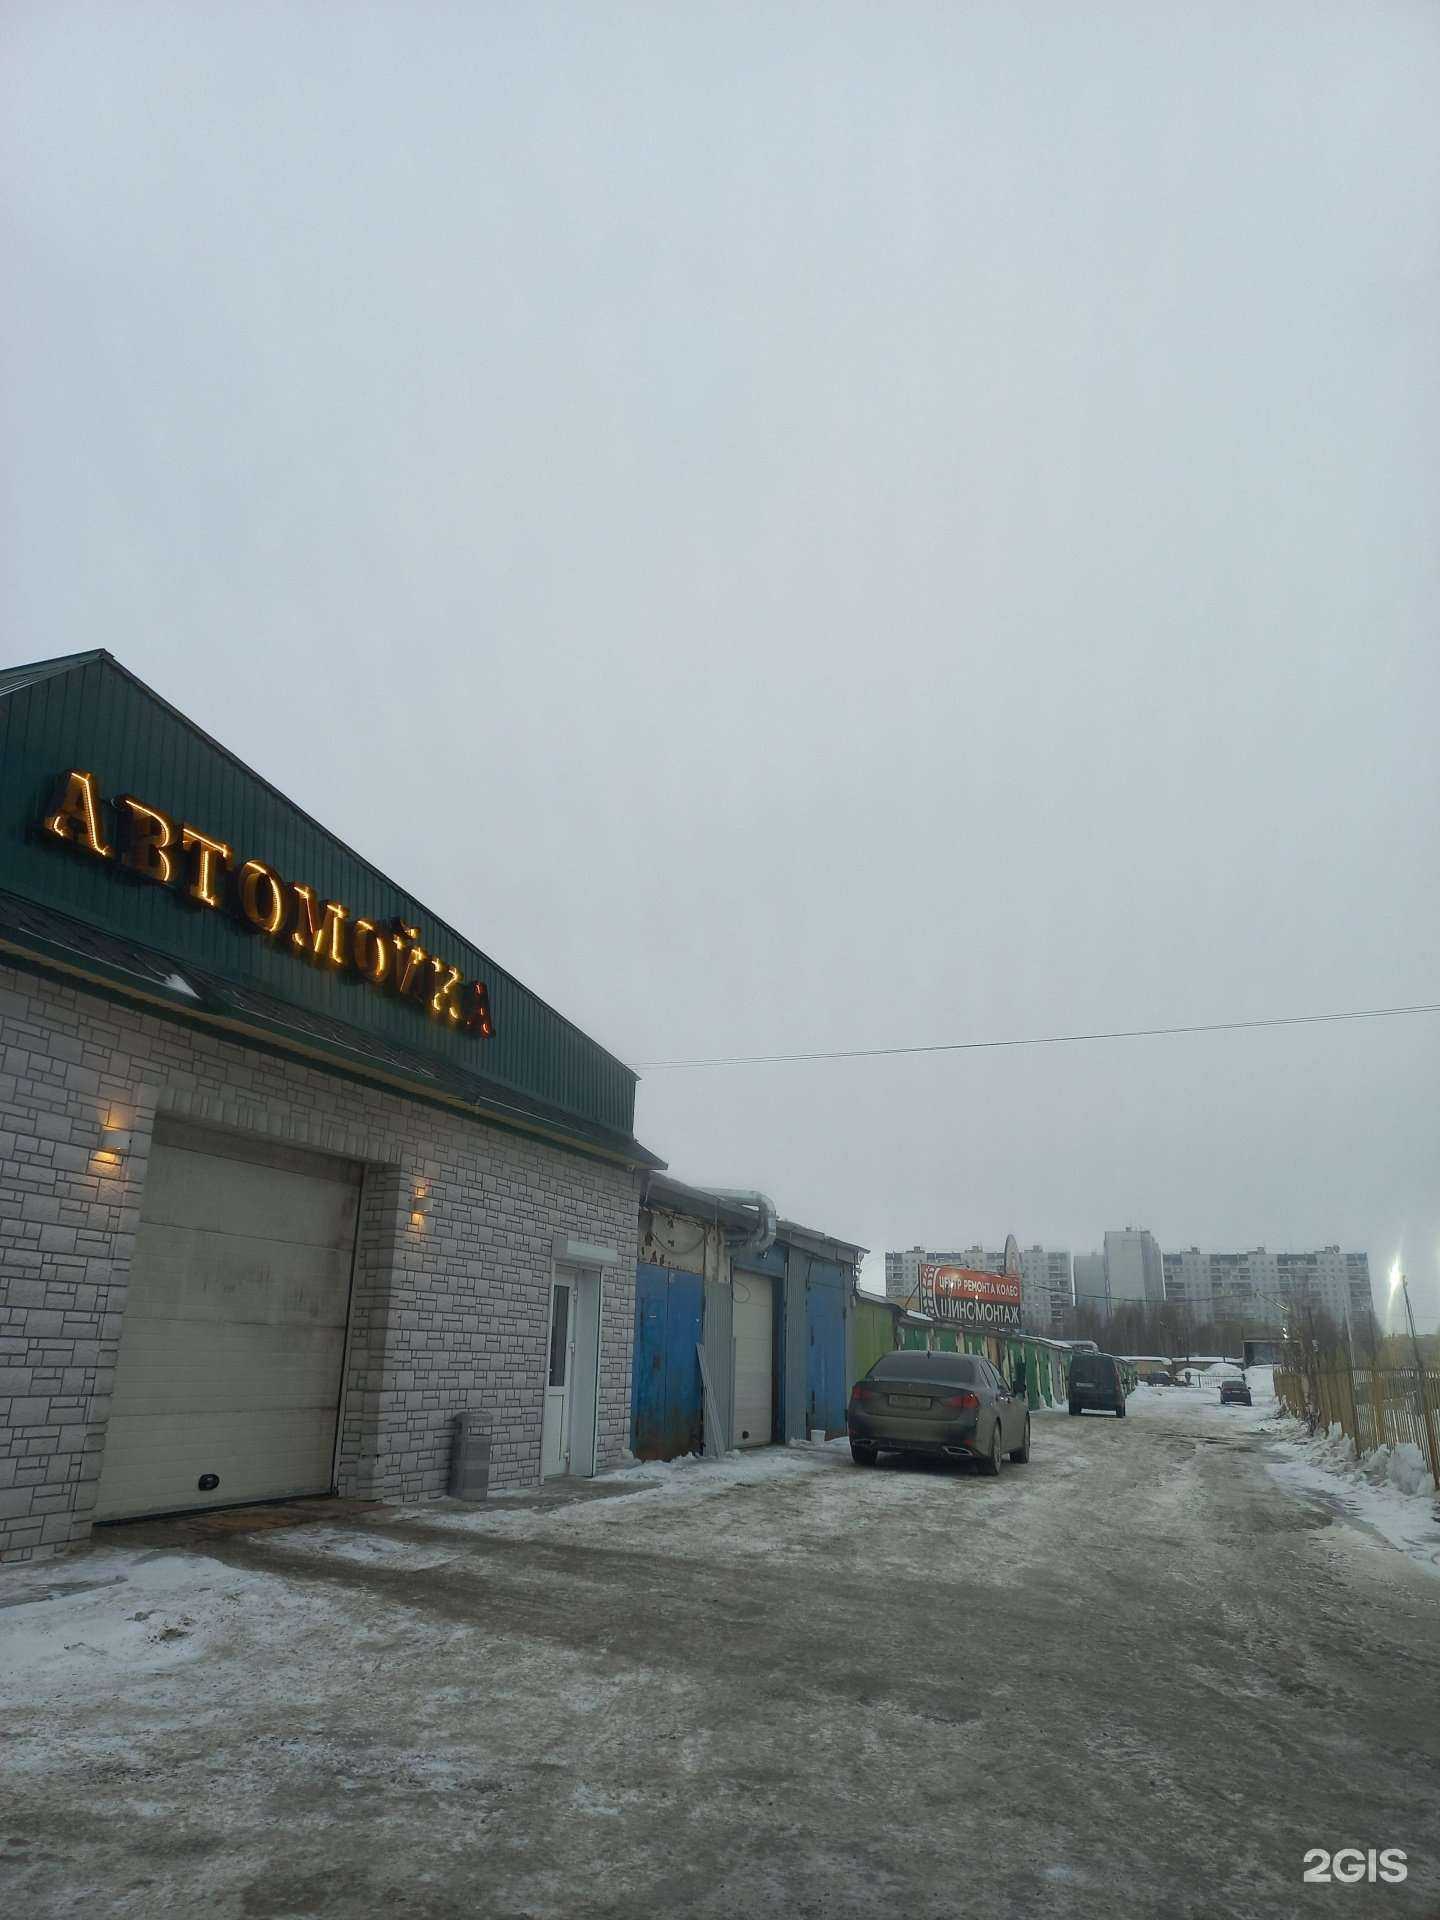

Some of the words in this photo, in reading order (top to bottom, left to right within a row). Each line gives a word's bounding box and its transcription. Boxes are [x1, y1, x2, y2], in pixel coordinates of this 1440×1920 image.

[42, 768, 494, 1039] АВТОМОЙКА
[939, 1275, 962, 1291] ЦЕНТР
[963, 1279, 996, 1295] РЕМОНТА
[996, 1283, 1018, 1297] КОЛЕС
